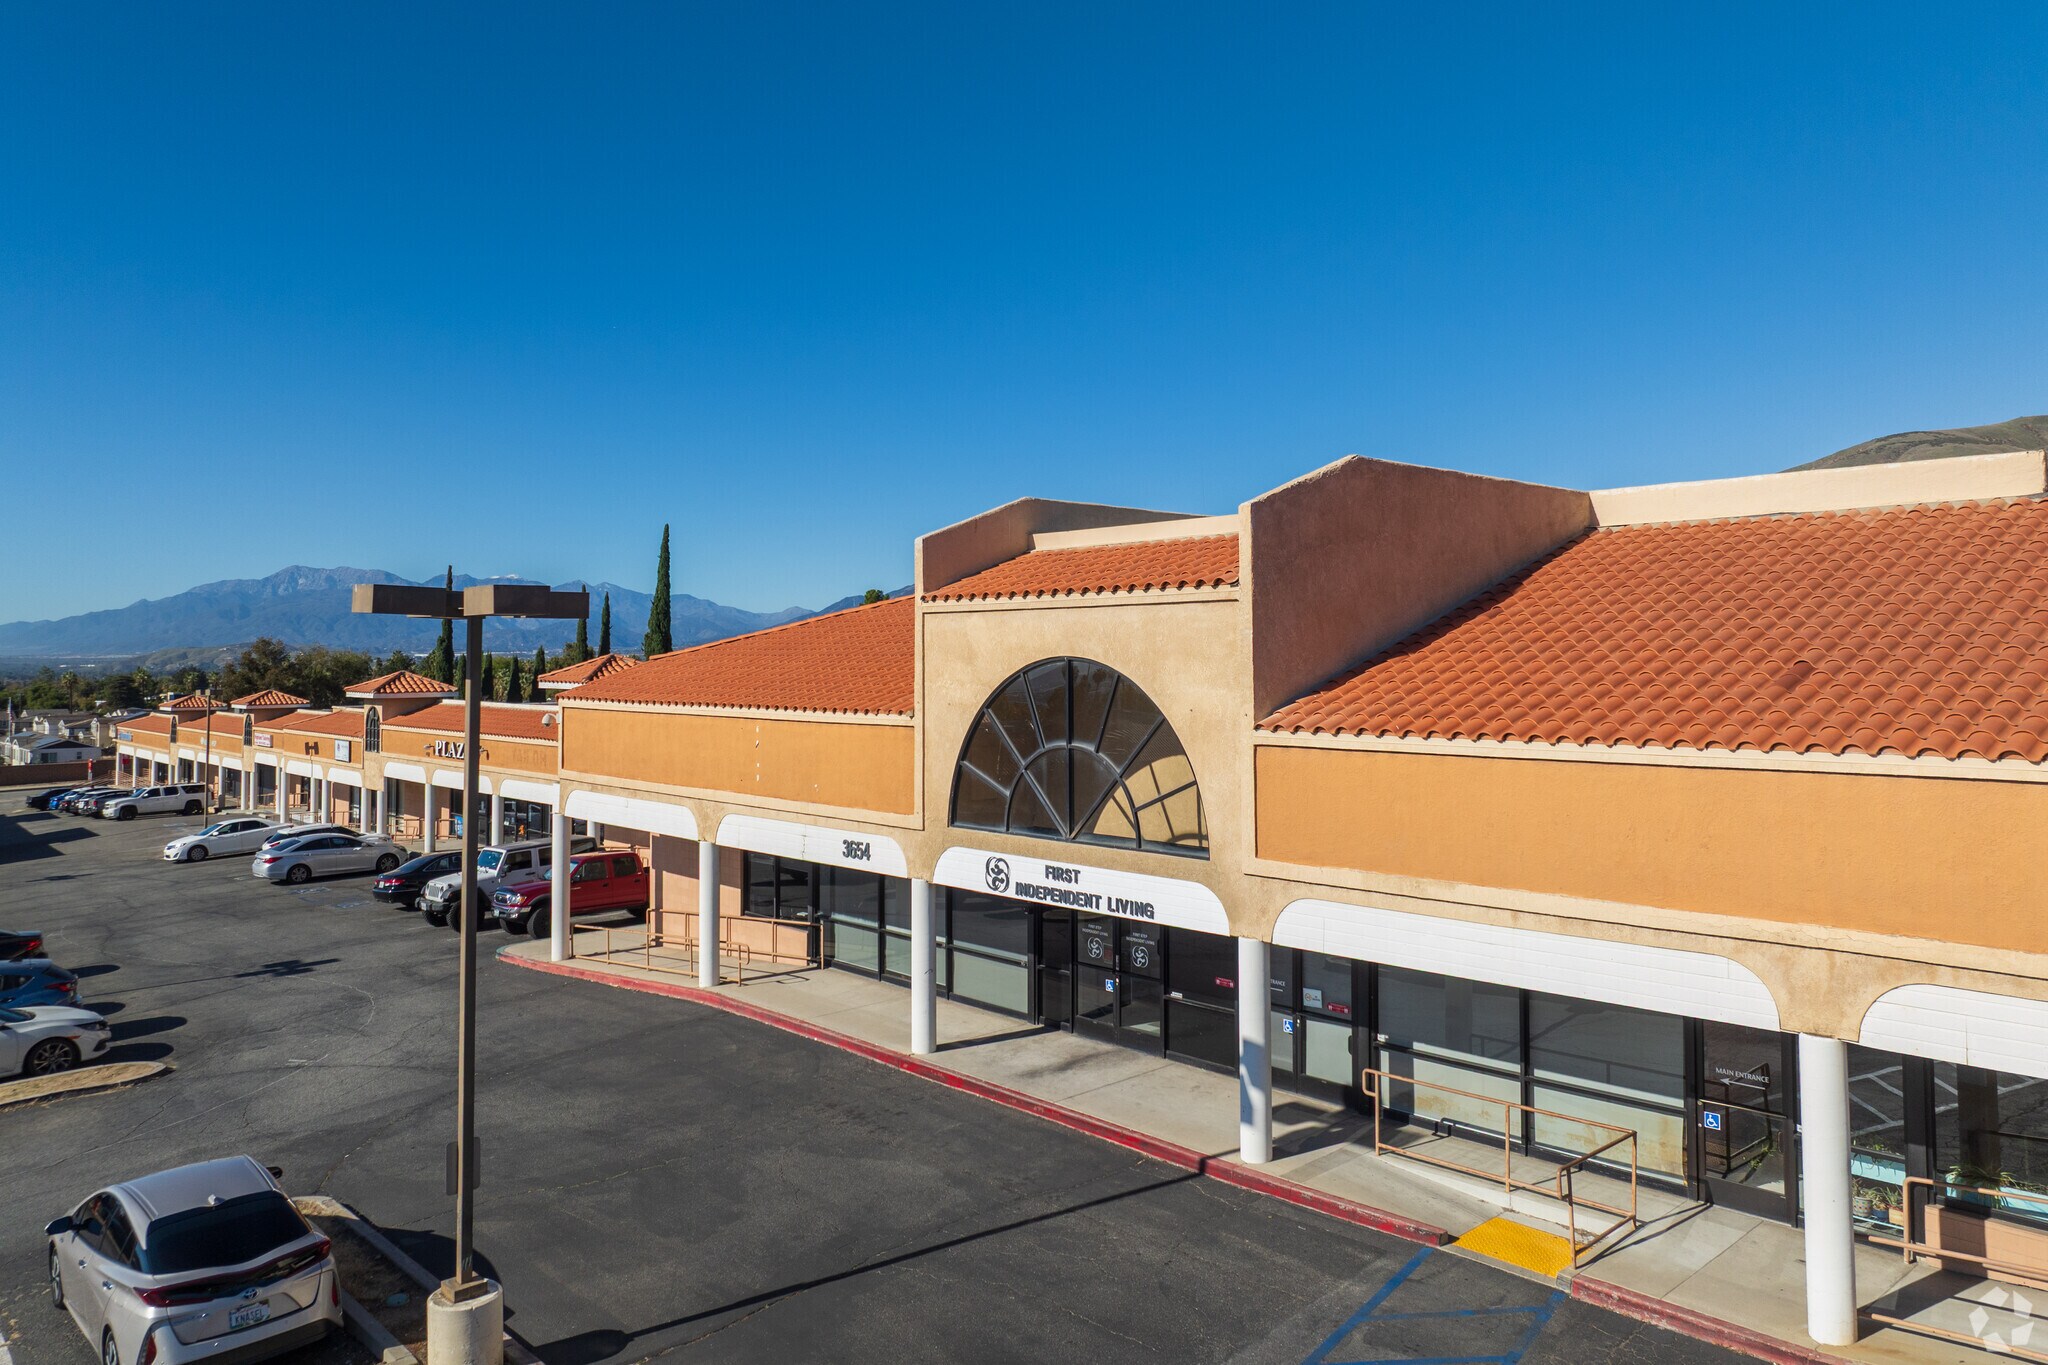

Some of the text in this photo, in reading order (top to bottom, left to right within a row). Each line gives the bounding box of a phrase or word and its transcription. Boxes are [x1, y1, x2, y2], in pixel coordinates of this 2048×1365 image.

[435, 740, 465, 760] PLAZ
[842, 839, 871, 861] 3654
[1045, 864, 1080, 885] FIRST
[1015, 881, 1155, 920] INDEPENDENT LIVING
[1270, 978, 1286, 987] TRANCE
[1715, 1067, 1770, 1083] MAIN ENTRANCE
